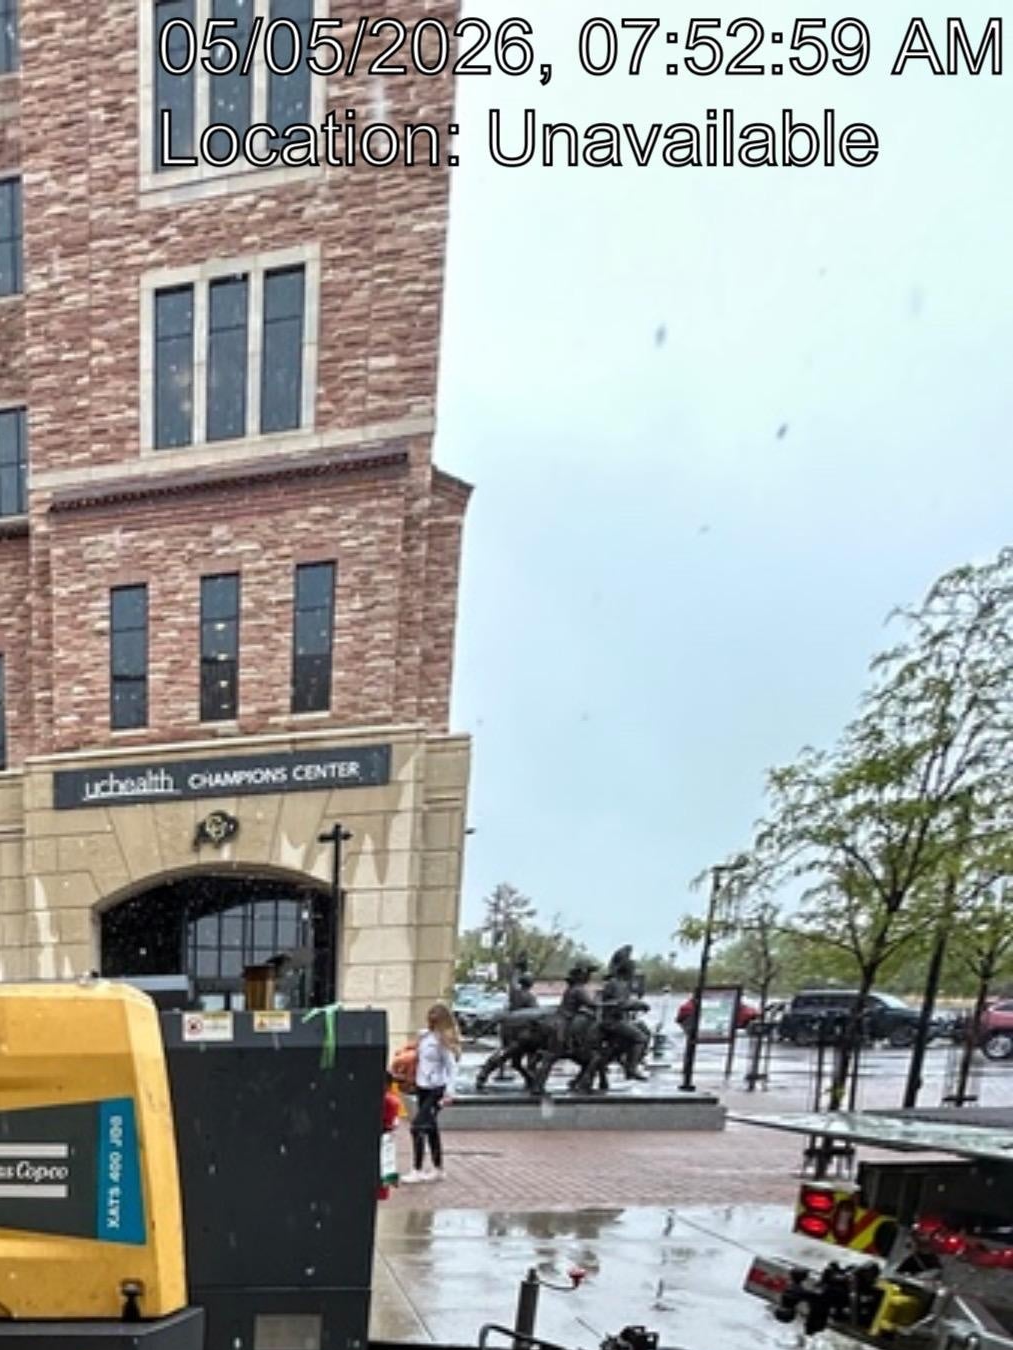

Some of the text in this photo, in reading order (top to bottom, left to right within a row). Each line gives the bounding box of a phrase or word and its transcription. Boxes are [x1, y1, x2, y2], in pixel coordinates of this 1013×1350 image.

[84, 761, 361, 799] uchealth CHAMPIONS CENTER
[15, 1160, 69, 1182] Copco
